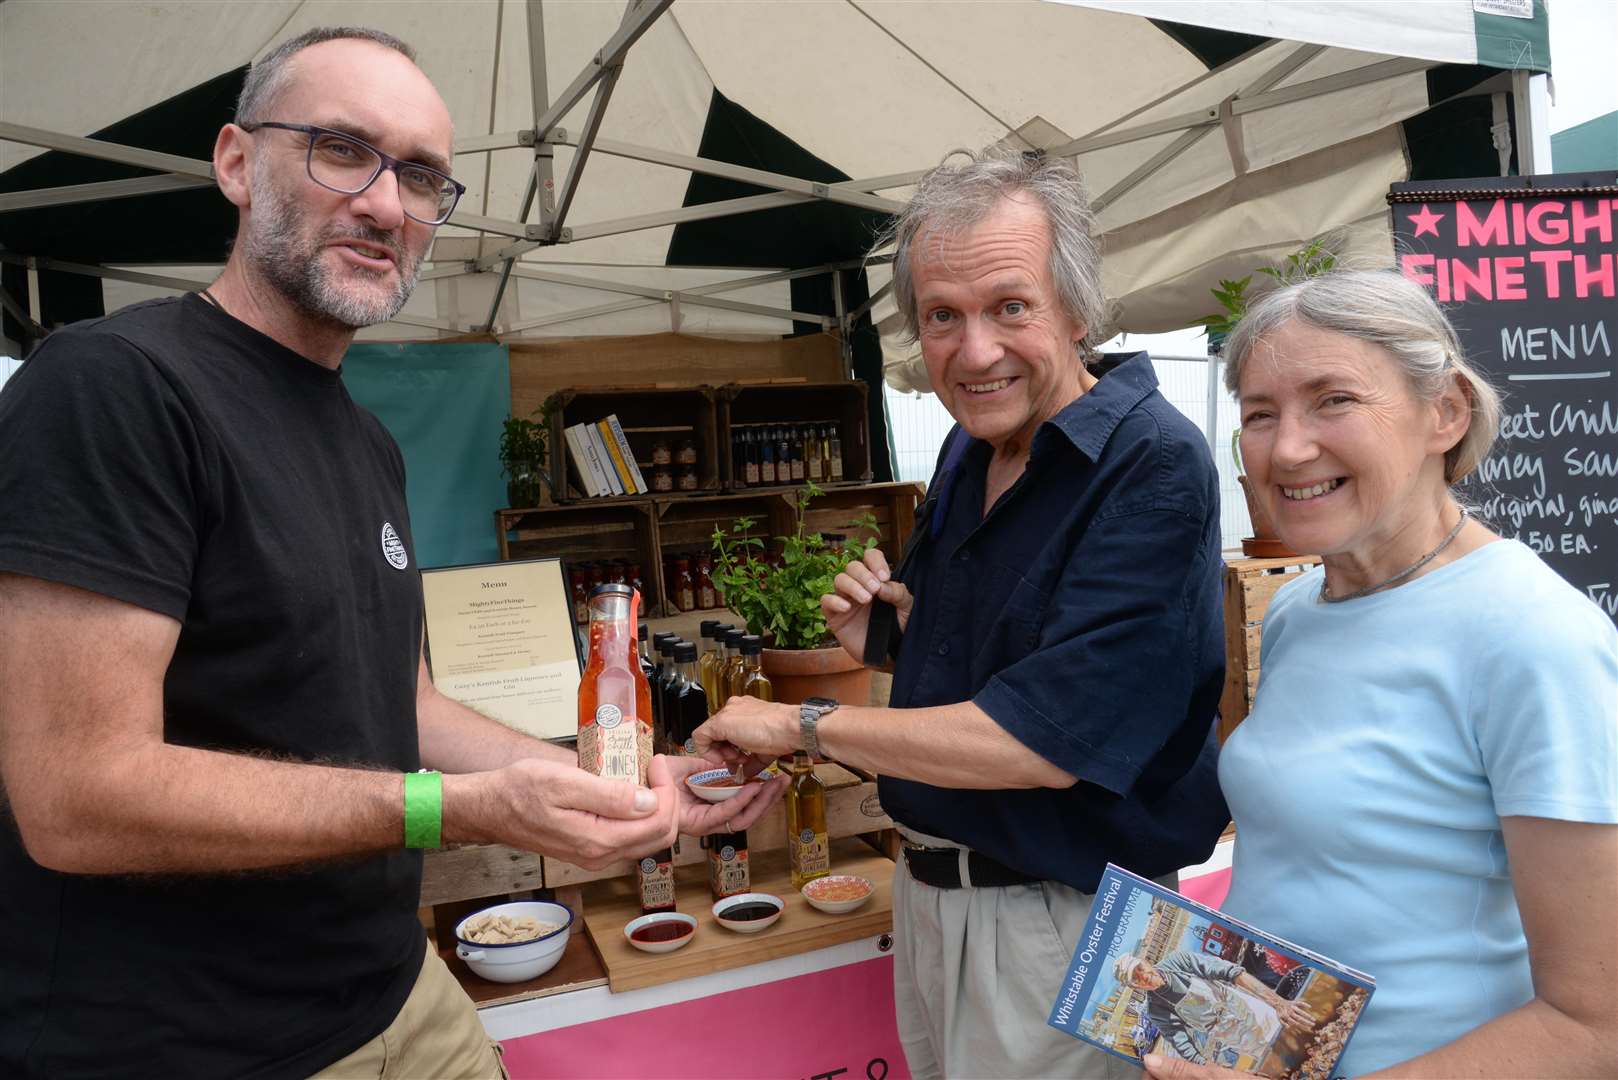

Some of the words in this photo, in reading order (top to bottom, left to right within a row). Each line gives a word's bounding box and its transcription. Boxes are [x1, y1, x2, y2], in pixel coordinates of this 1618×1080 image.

[1530, 250, 1618, 299] TH
[1501, 320, 1612, 362] MENU
[1496, 403, 1545, 439] eet
[1550, 399, 1618, 437] Chil
[1561, 533, 1598, 555] EA.
[481, 581, 508, 589] Menu
[605, 755, 636, 777] HONEY
[1107, 887, 1142, 958] PROGRAMME
[1054, 967, 1088, 1026] Whitstable
[1080, 923, 1104, 963] Oyster
[1095, 877, 1122, 923] Festival
